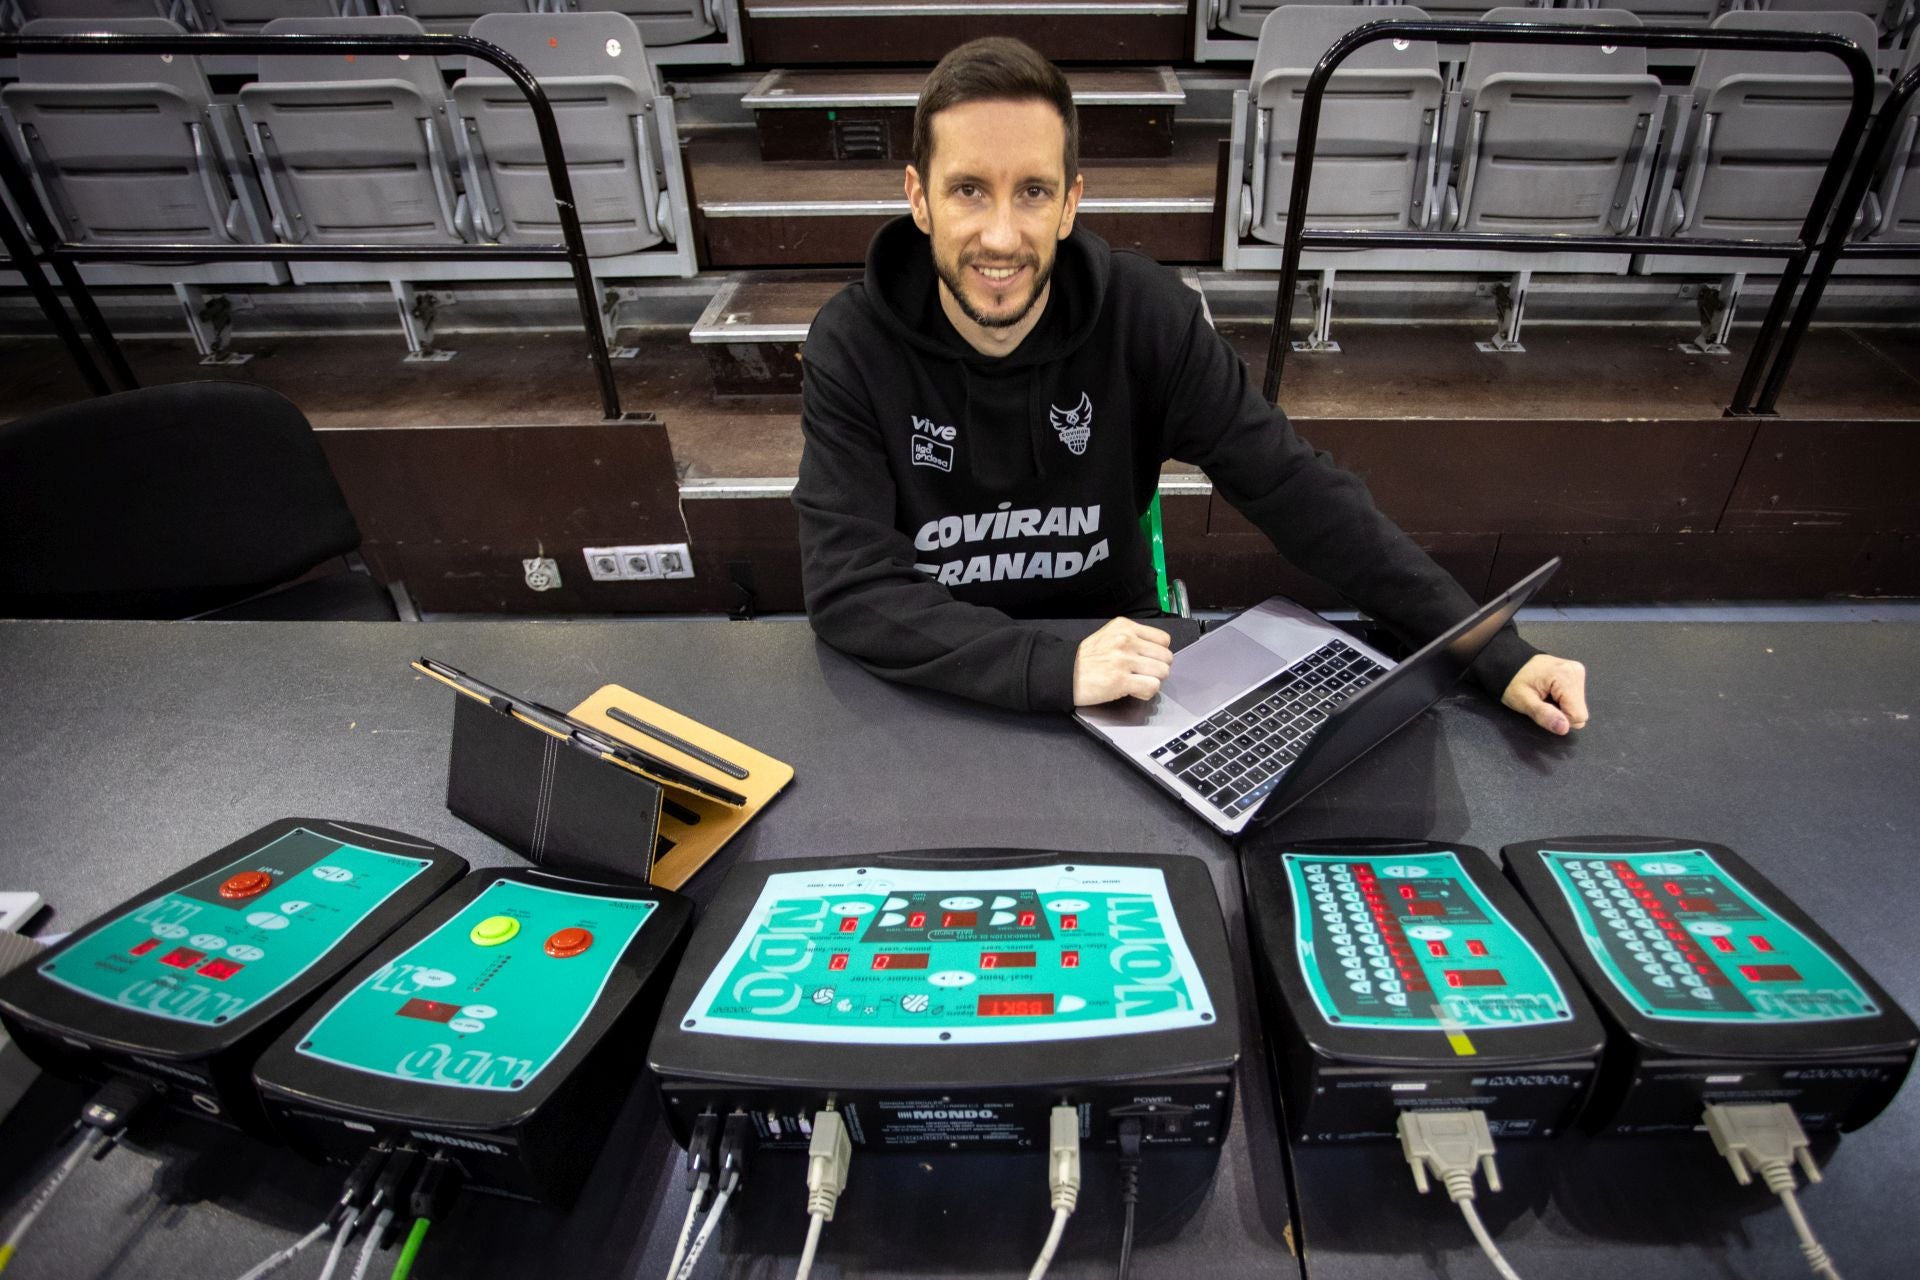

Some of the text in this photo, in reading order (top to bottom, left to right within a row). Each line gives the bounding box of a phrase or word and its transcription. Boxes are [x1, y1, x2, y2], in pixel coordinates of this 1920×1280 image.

[911, 415, 957, 441] vive
[915, 444, 932, 455] liga
[915, 453, 948, 467] endesa
[831, 954, 848, 969] 0
[873, 955, 890, 969] 0
[981, 955, 997, 969] 0
[978, 974, 1033, 982] local/home
[989, 1001, 1043, 1016] BSKT
[1133, 1096, 1172, 1104] POWER
[913, 1109, 993, 1120] MONDO
